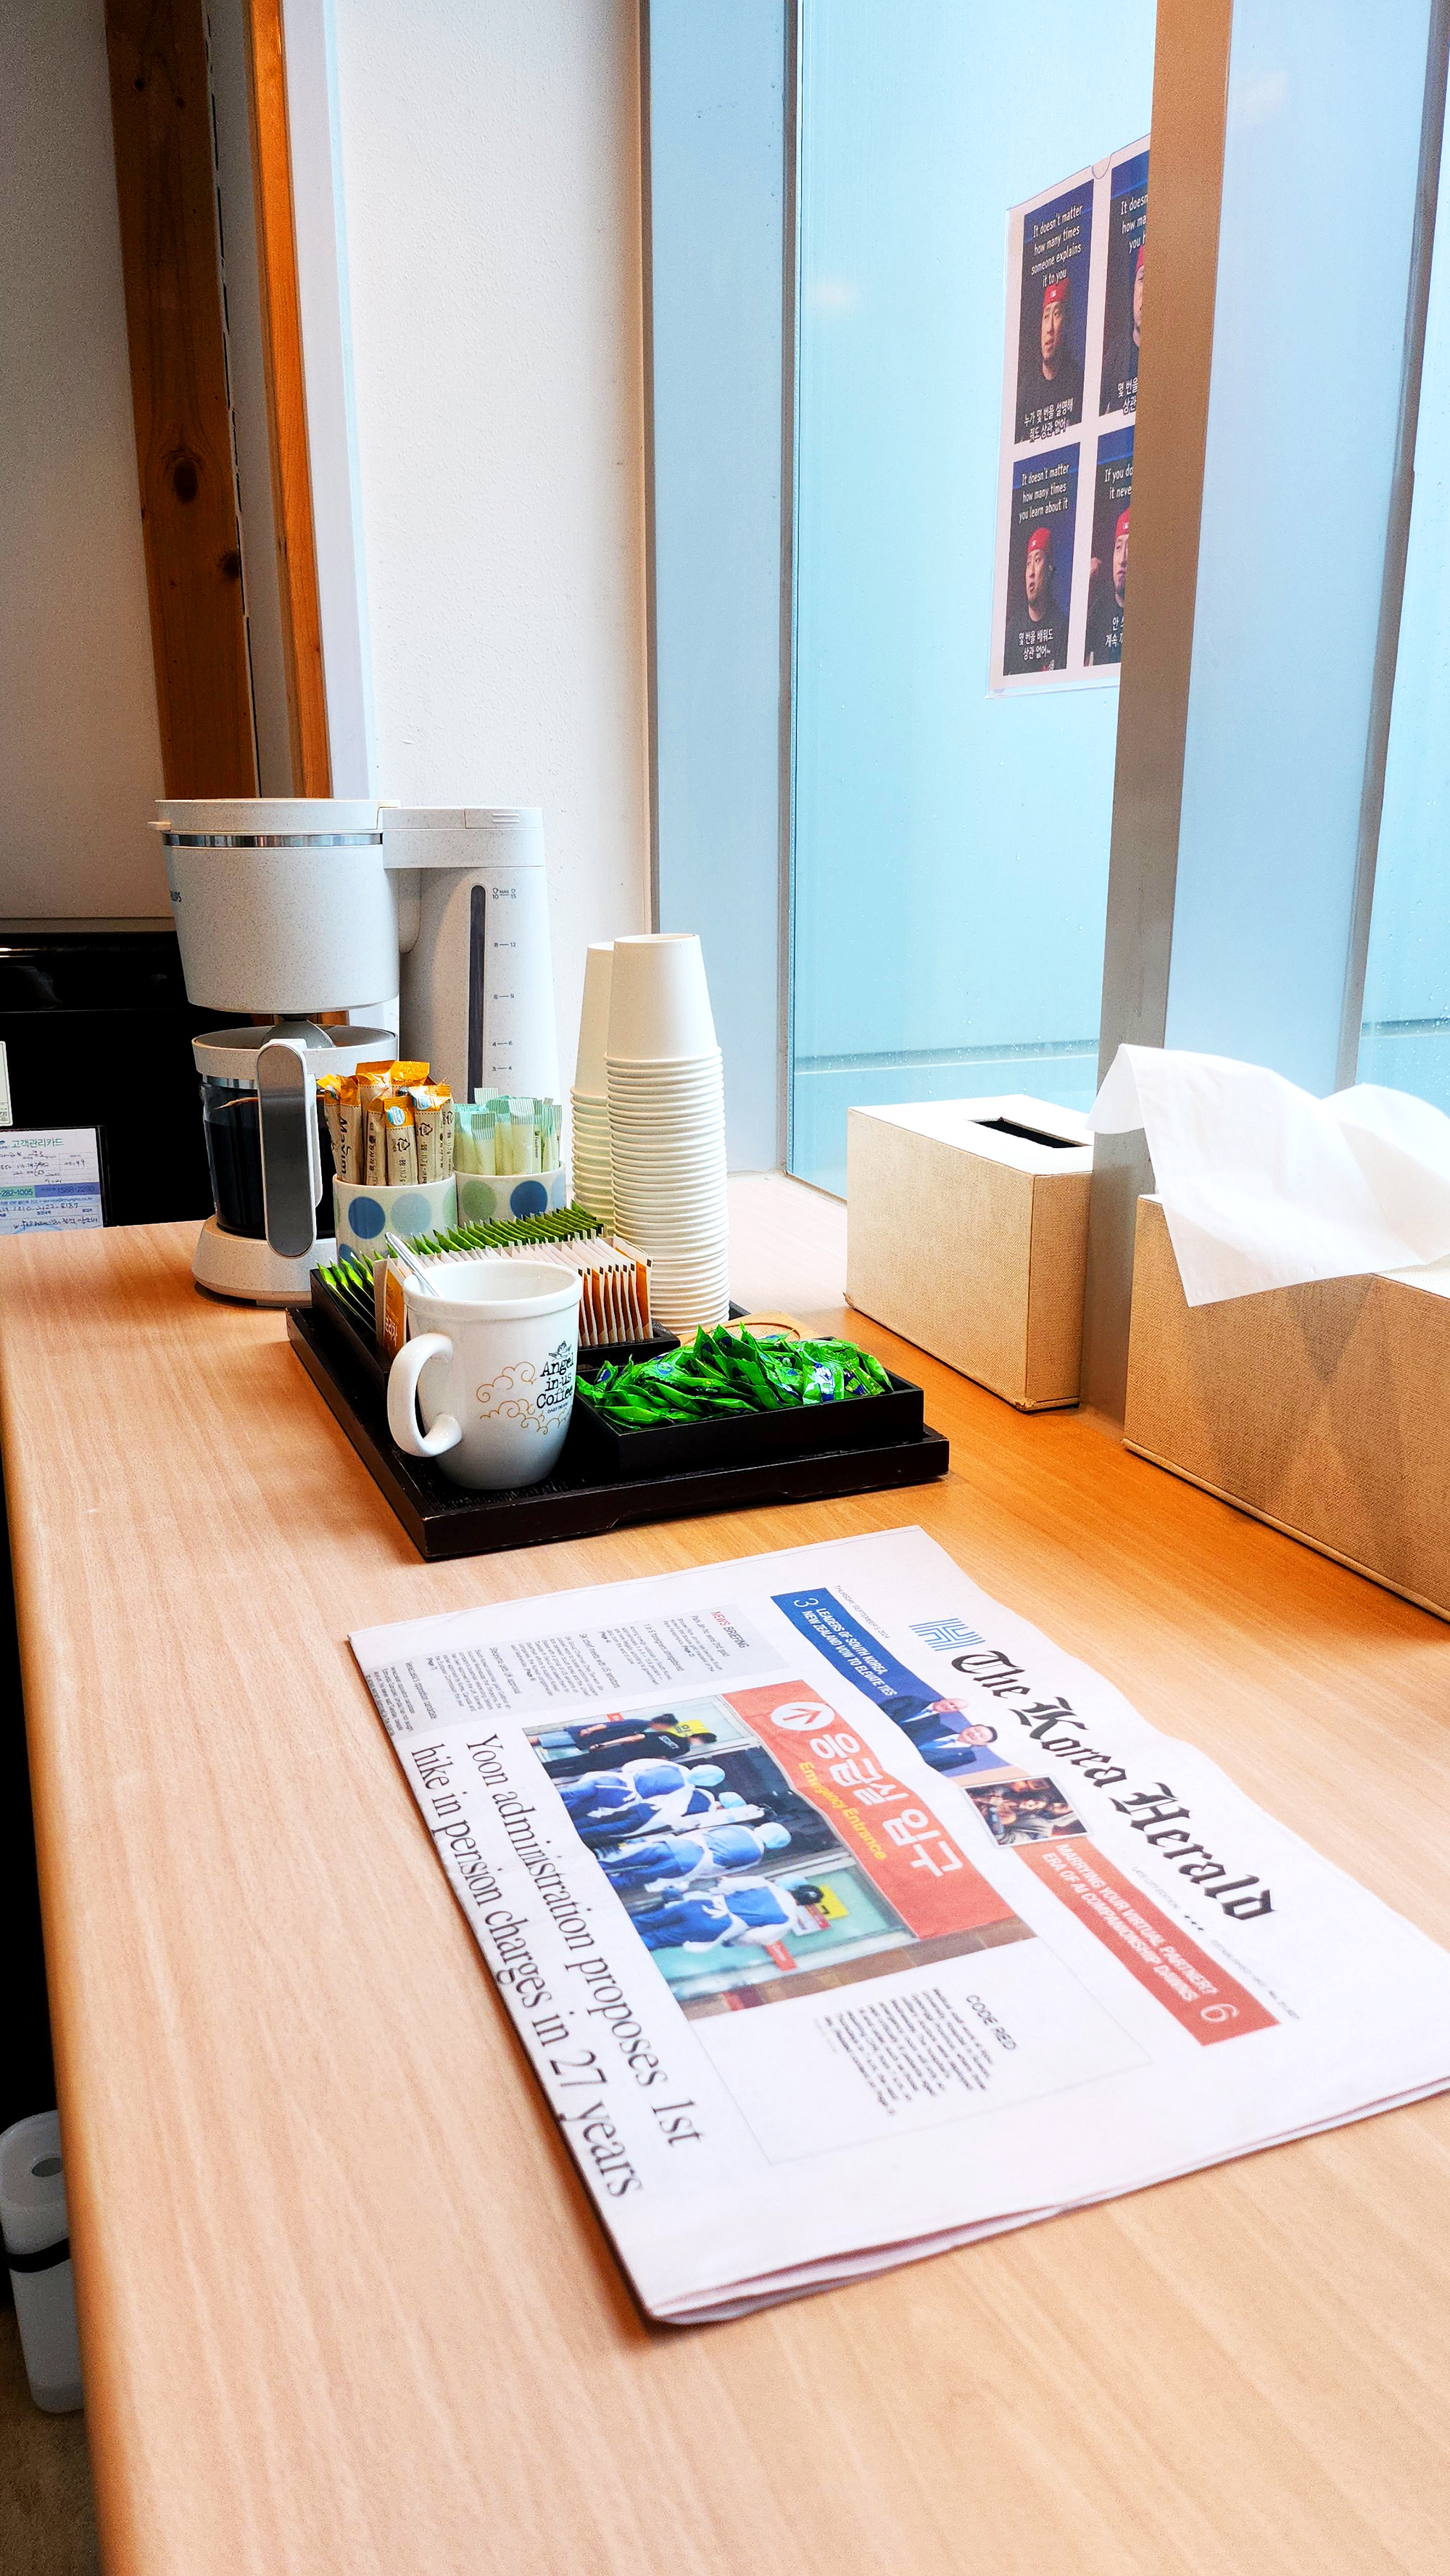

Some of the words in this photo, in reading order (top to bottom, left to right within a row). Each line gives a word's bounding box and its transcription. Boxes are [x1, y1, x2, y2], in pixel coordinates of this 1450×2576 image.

[1120, 198, 1127, 215] It
[1032, 226, 1038, 238] It
[1040, 213, 1061, 234] doesn't
[1061, 205, 1083, 223] matter
[1122, 220, 1135, 234] how
[1034, 243, 1046, 256] how
[1046, 234, 1061, 250] many
[1062, 225, 1080, 242] times
[1129, 237, 1141, 254] you
[1031, 257, 1054, 276] someone
[1056, 242, 1082, 264] explains
[1042, 273, 1048, 288] it
[1048, 273, 1055, 285] to
[1056, 268, 1067, 284] you
[1117, 381, 1124, 398] 몇
[1125, 377, 1139, 395] 번을
[1024, 410, 1035, 427] 누가
[1022, 473, 1027, 487] It
[1028, 466, 1048, 483] doesn't
[1049, 463, 1070, 479] matter
[1104, 468, 1111, 482] If
[1111, 468, 1124, 484] you
[1022, 490, 1034, 503] how
[1034, 487, 1049, 501] many
[1050, 482, 1067, 495] times
[1109, 487, 1115, 500] it
[1019, 510, 1029, 524] you
[1029, 505, 1045, 519] learn
[1045, 500, 1062, 514] about
[1063, 497, 1069, 511] it
[12, 1137, 65, 1149] 고객관리카드
[339, 1117, 351, 1174] Maxim
[540, 1352, 574, 1377] Angel
[544, 1372, 572, 1392] in-us
[536, 1385, 573, 1409] Coffee
[793, 1597, 819, 1607] 3
[801, 1610, 821, 1624] NEW
[852, 1604, 878, 1627] SEPTEMBER
[690, 1614, 700, 1623] Park
[705, 1634, 717, 1643] wins
[710, 1611, 730, 1626] NEWS
[722, 1626, 750, 1648] BRIEFING
[812, 1623, 842, 1646] ZEALAND
[816, 1607, 845, 1632] LEADERS
[845, 1638, 870, 1656] SOUTH
[650, 1632, 667, 1650] foreigners
[662, 1650, 684, 1671] unregistered
[835, 1644, 855, 1657] VOW
[847, 1656, 862, 1666] TO
[506, 1678, 521, 1694] approval
[604, 1672, 621, 1688] senators
[853, 1664, 885, 1686] ELEVATE
[414, 1682, 428, 1701] opposition
[423, 1701, 436, 1720] candidate
[877, 1684, 898, 1696] TIES
[410, 1743, 454, 1789] hike
[950, 1650, 1030, 1698] The
[1008, 1696, 1127, 1788] Korea
[1109, 1782, 1275, 1920] Herald
[431, 1791, 468, 1817] in
[808, 1733, 908, 1806] 응급실
[882, 1808, 964, 1876] 입구
[841, 1807, 887, 1859] Entrance
[433, 1819, 503, 1907] pension
[1042, 1852, 1066, 1870] ERA
[1059, 1870, 1080, 1881] OF
[1070, 1883, 1089, 1893] AI
[1081, 1892, 1161, 1964] COMPANIONSHIP
[1153, 1964, 1198, 2001] DAWNS
[1055, 1843, 1105, 1888] MARRYING
[1098, 1886, 1130, 1910] YOUR
[1122, 1909, 1164, 1947] VIRTUAL
[1159, 1945, 1217, 1993] PARTNER?
[465, 1733, 508, 1787] Yoon
[491, 1791, 594, 1951] administration
[564, 1957, 668, 2087] proposes
[651, 2099, 703, 2147] 1st
[484, 1910, 551, 2008] charges
[966, 1995, 998, 2026] CODE
[995, 2027, 1016, 2049] RED
[1200, 2003, 1239, 2023] 6
[531, 2010, 574, 2047] in
[549, 2051, 608, 2087] 27
[559, 2101, 642, 2198] years
